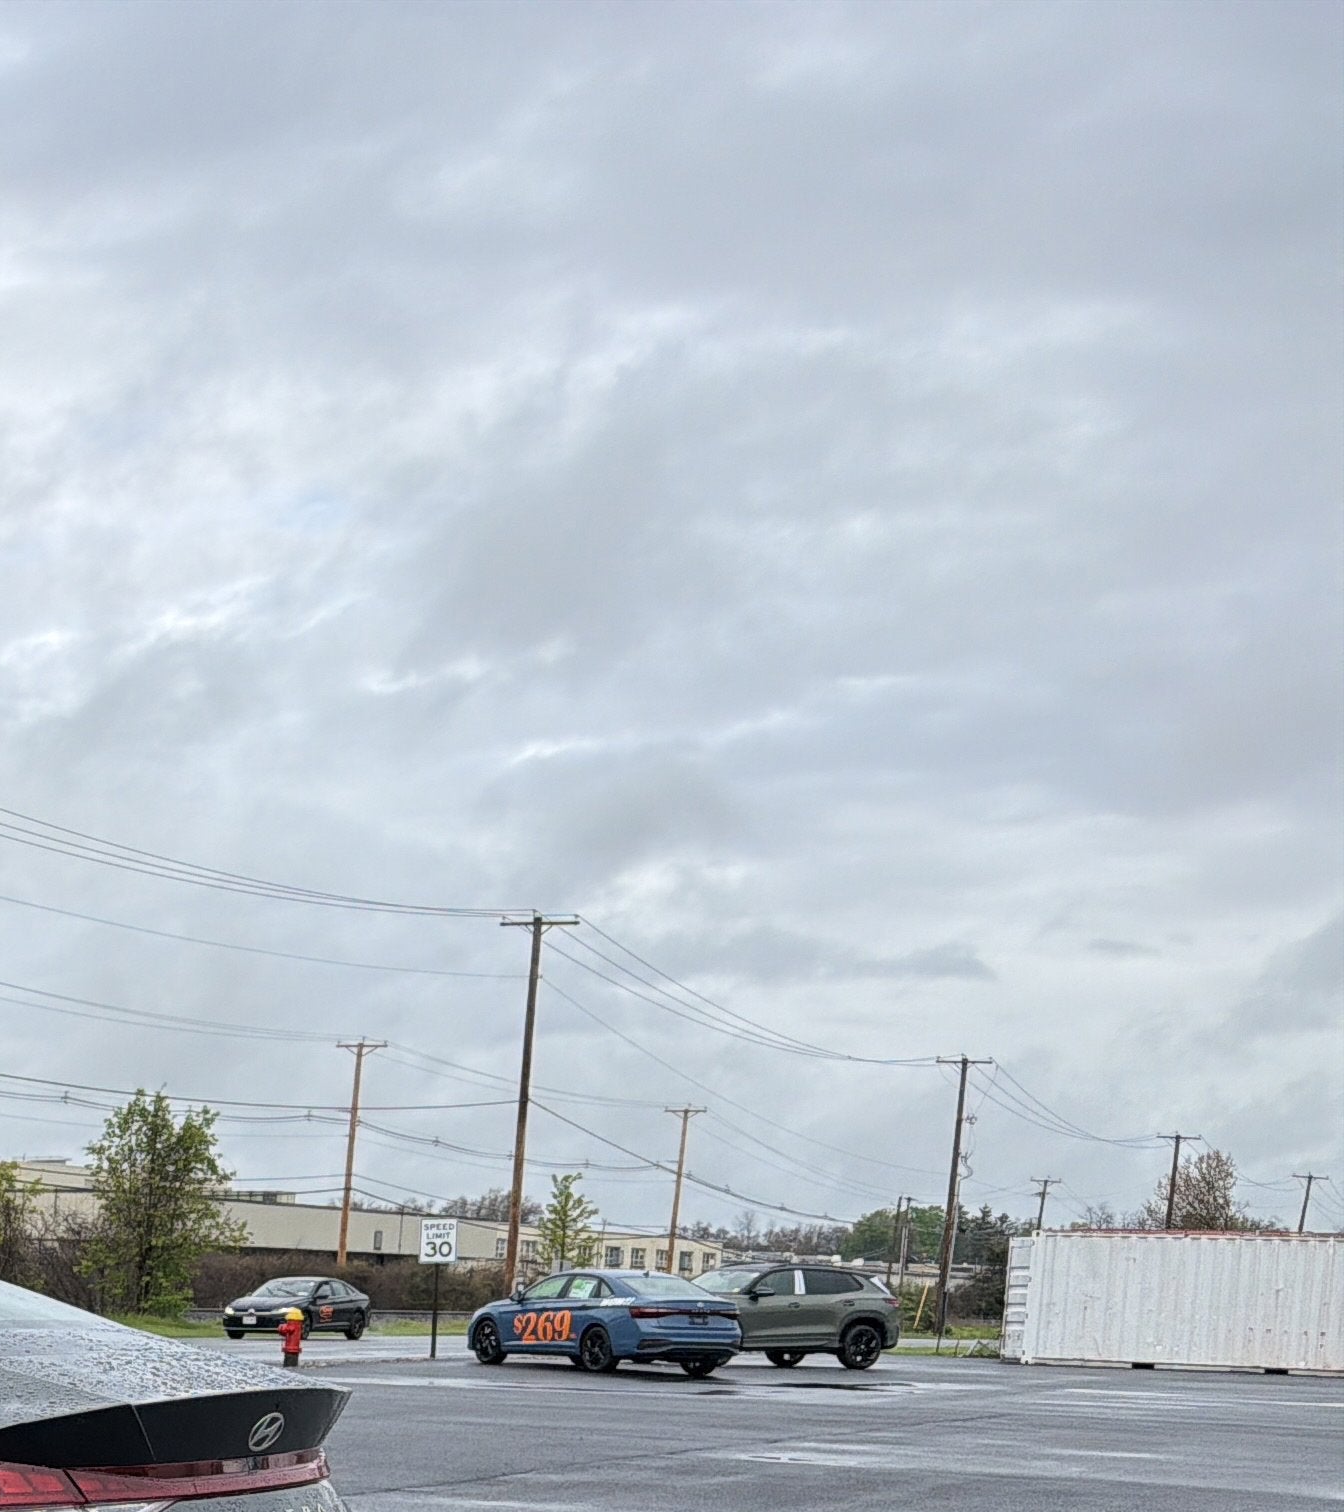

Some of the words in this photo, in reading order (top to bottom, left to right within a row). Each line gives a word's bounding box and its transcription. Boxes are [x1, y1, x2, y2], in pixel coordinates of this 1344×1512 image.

[423, 1222, 455, 1231] SPEED
[426, 1231, 451, 1240] LIMIT
[424, 1241, 452, 1258] 30
[513, 1309, 572, 1344] $269
